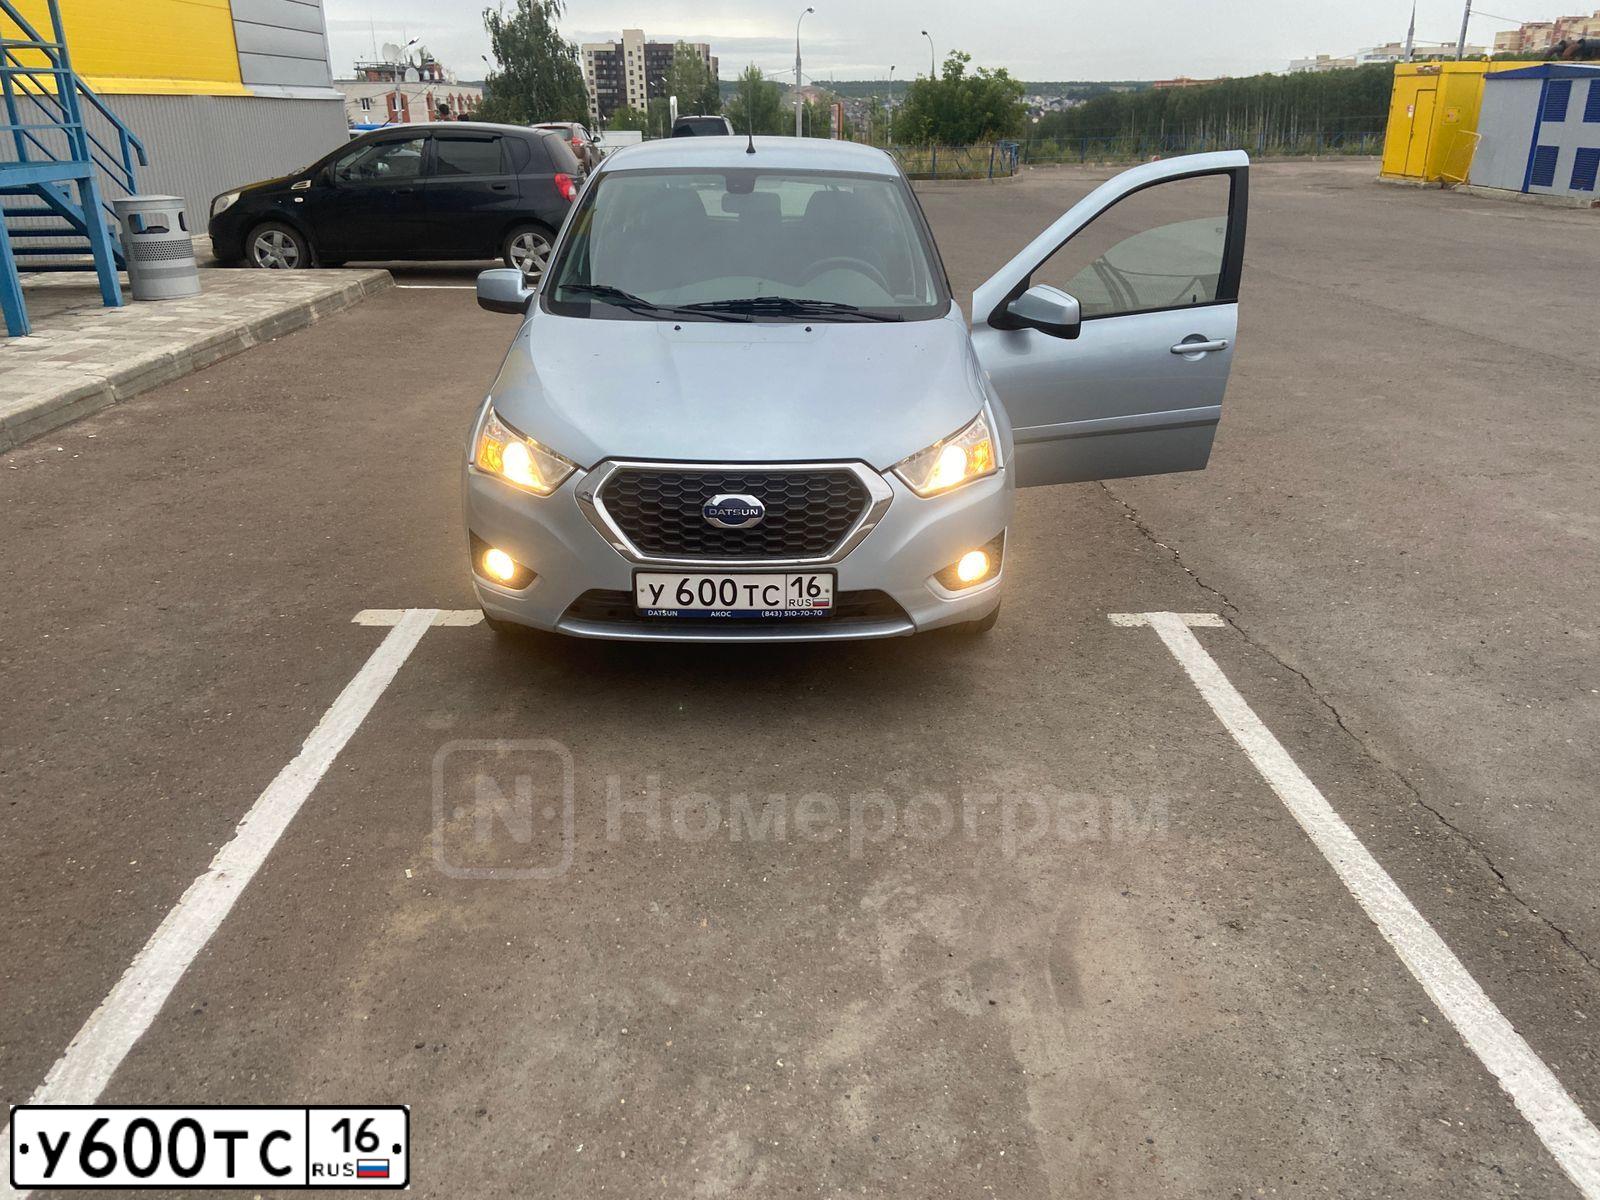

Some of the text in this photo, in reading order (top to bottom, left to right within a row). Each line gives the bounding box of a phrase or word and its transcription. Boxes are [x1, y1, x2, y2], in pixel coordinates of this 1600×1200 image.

[708, 507, 759, 516] DATSUN
[790, 576, 821, 598] 16
[788, 598, 811, 607] RUS
[647, 609, 678, 617] DATSUN
